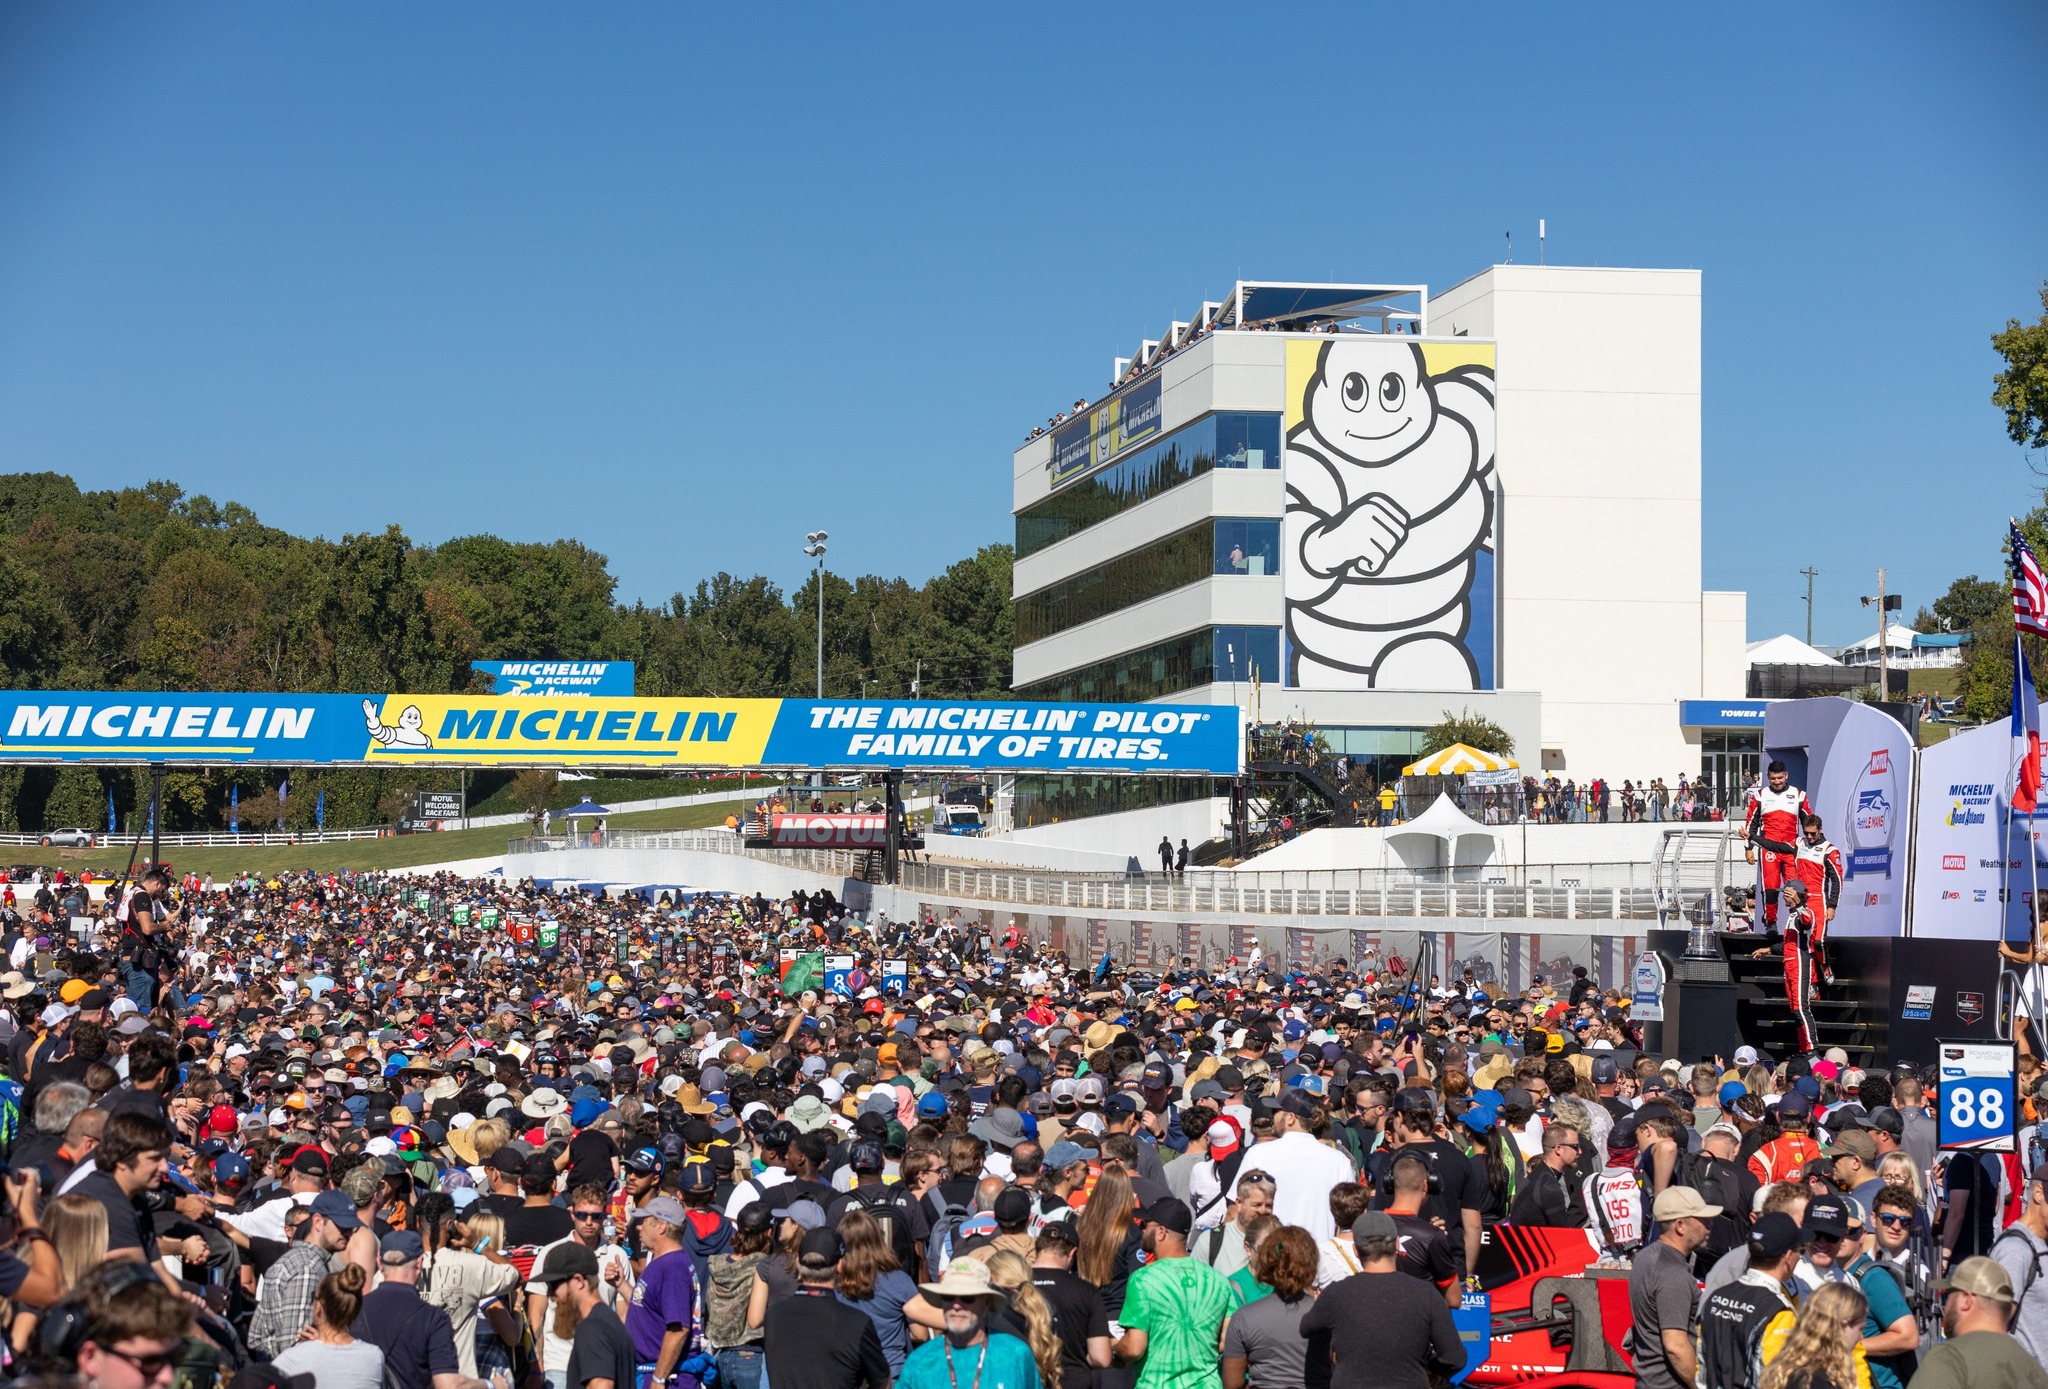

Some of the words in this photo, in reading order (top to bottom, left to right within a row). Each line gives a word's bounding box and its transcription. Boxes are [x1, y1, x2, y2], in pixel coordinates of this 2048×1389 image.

[501, 664, 608, 675] MICHELIN
[534, 677, 601, 685] RACEWAY
[7, 706, 315, 738] MICHELIN
[810, 707, 883, 729] THE
[438, 709, 737, 742] MICHELIN
[847, 734, 994, 757] FAMILY
[998, 736, 1051, 758] OF
[1058, 738, 1169, 761] TIRES.
[1949, 784, 1994, 795] MICHELIN
[431, 795, 453, 803] MOTUL
[425, 802, 460, 810] WELCOMES
[425, 809, 442, 817] RACE
[1951, 808, 1966, 825] Road
[1965, 808, 1985, 825] Atlanta
[777, 818, 886, 843] MOTUL
[1943, 857, 1965, 869] MOTUL
[419, 901, 429, 909] 47
[455, 913, 467, 922] 45
[483, 917, 495, 927] 57
[522, 928, 528, 937] 9
[543, 932, 557, 943] 96
[583, 940, 590, 950] 19
[713, 961, 724, 974] 23
[1950, 1087, 2004, 1129] 88
[1606, 1199, 1629, 1221] 156
[1711, 1295, 1756, 1313] CADILLAC
[1711, 1308, 1744, 1323] RACNG
